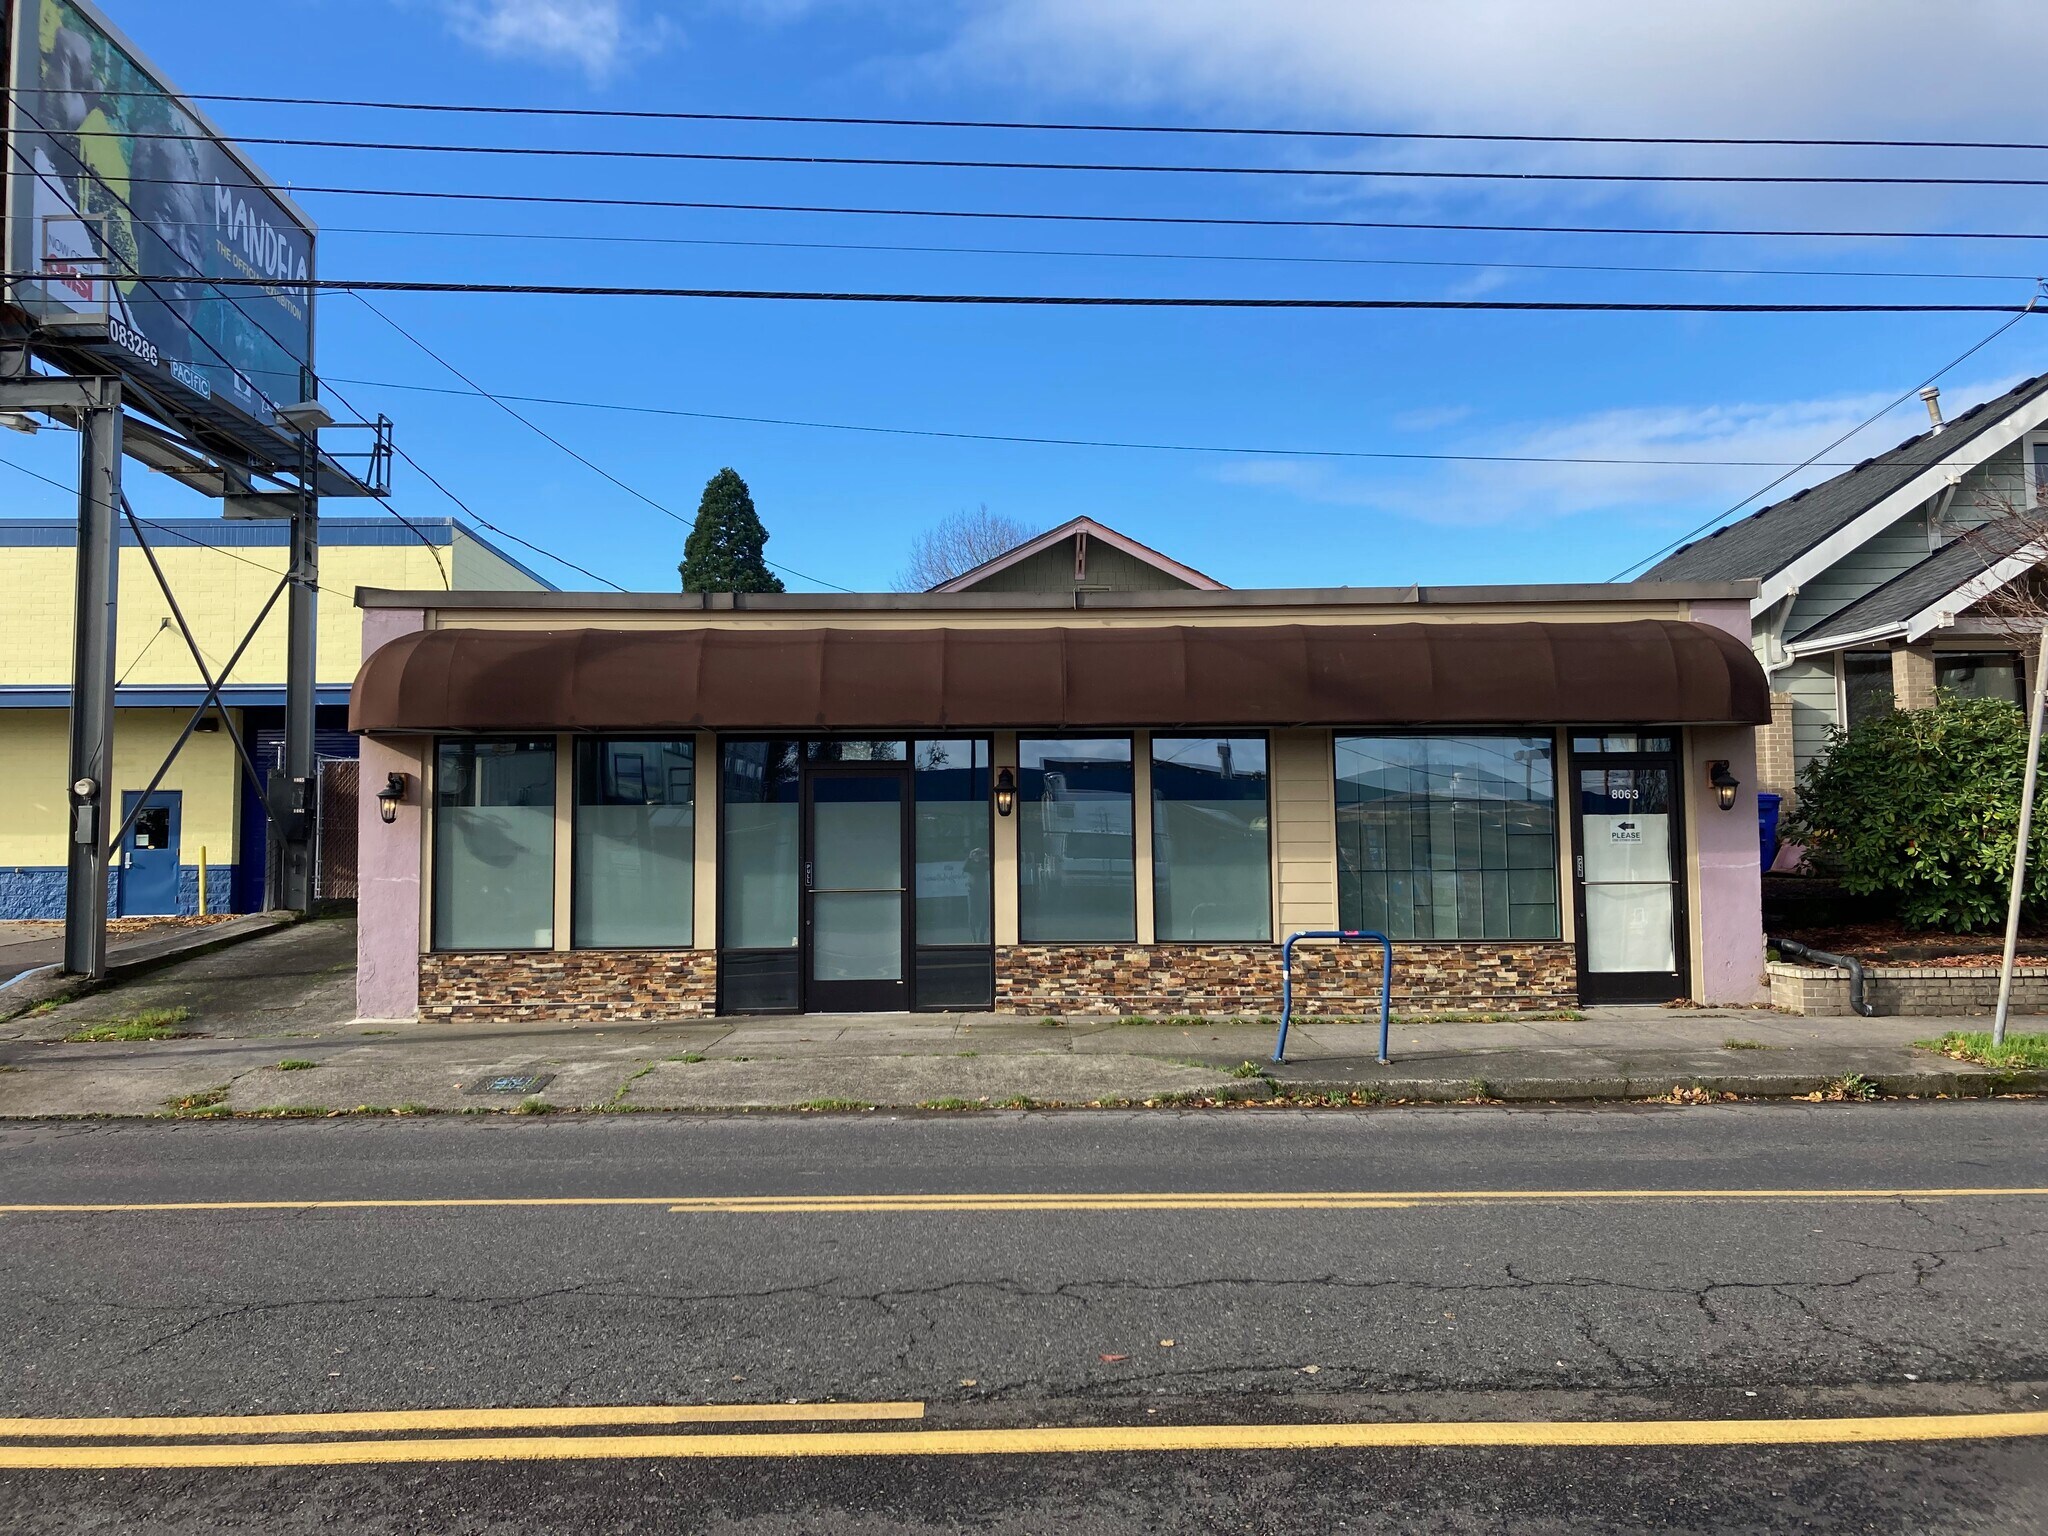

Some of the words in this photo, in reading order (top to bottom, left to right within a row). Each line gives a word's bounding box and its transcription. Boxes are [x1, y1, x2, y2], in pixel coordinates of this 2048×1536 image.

[48, 234, 69, 256] NOW
[214, 176, 308, 305] MANDELA
[216, 238, 231, 263] THE
[233, 253, 264, 290] OFFICIA
[265, 285, 302, 321] EXHIBITION
[110, 319, 158, 367] 083286
[172, 361, 209, 396] PACIFIC
[1611, 789, 1639, 799] 8063
